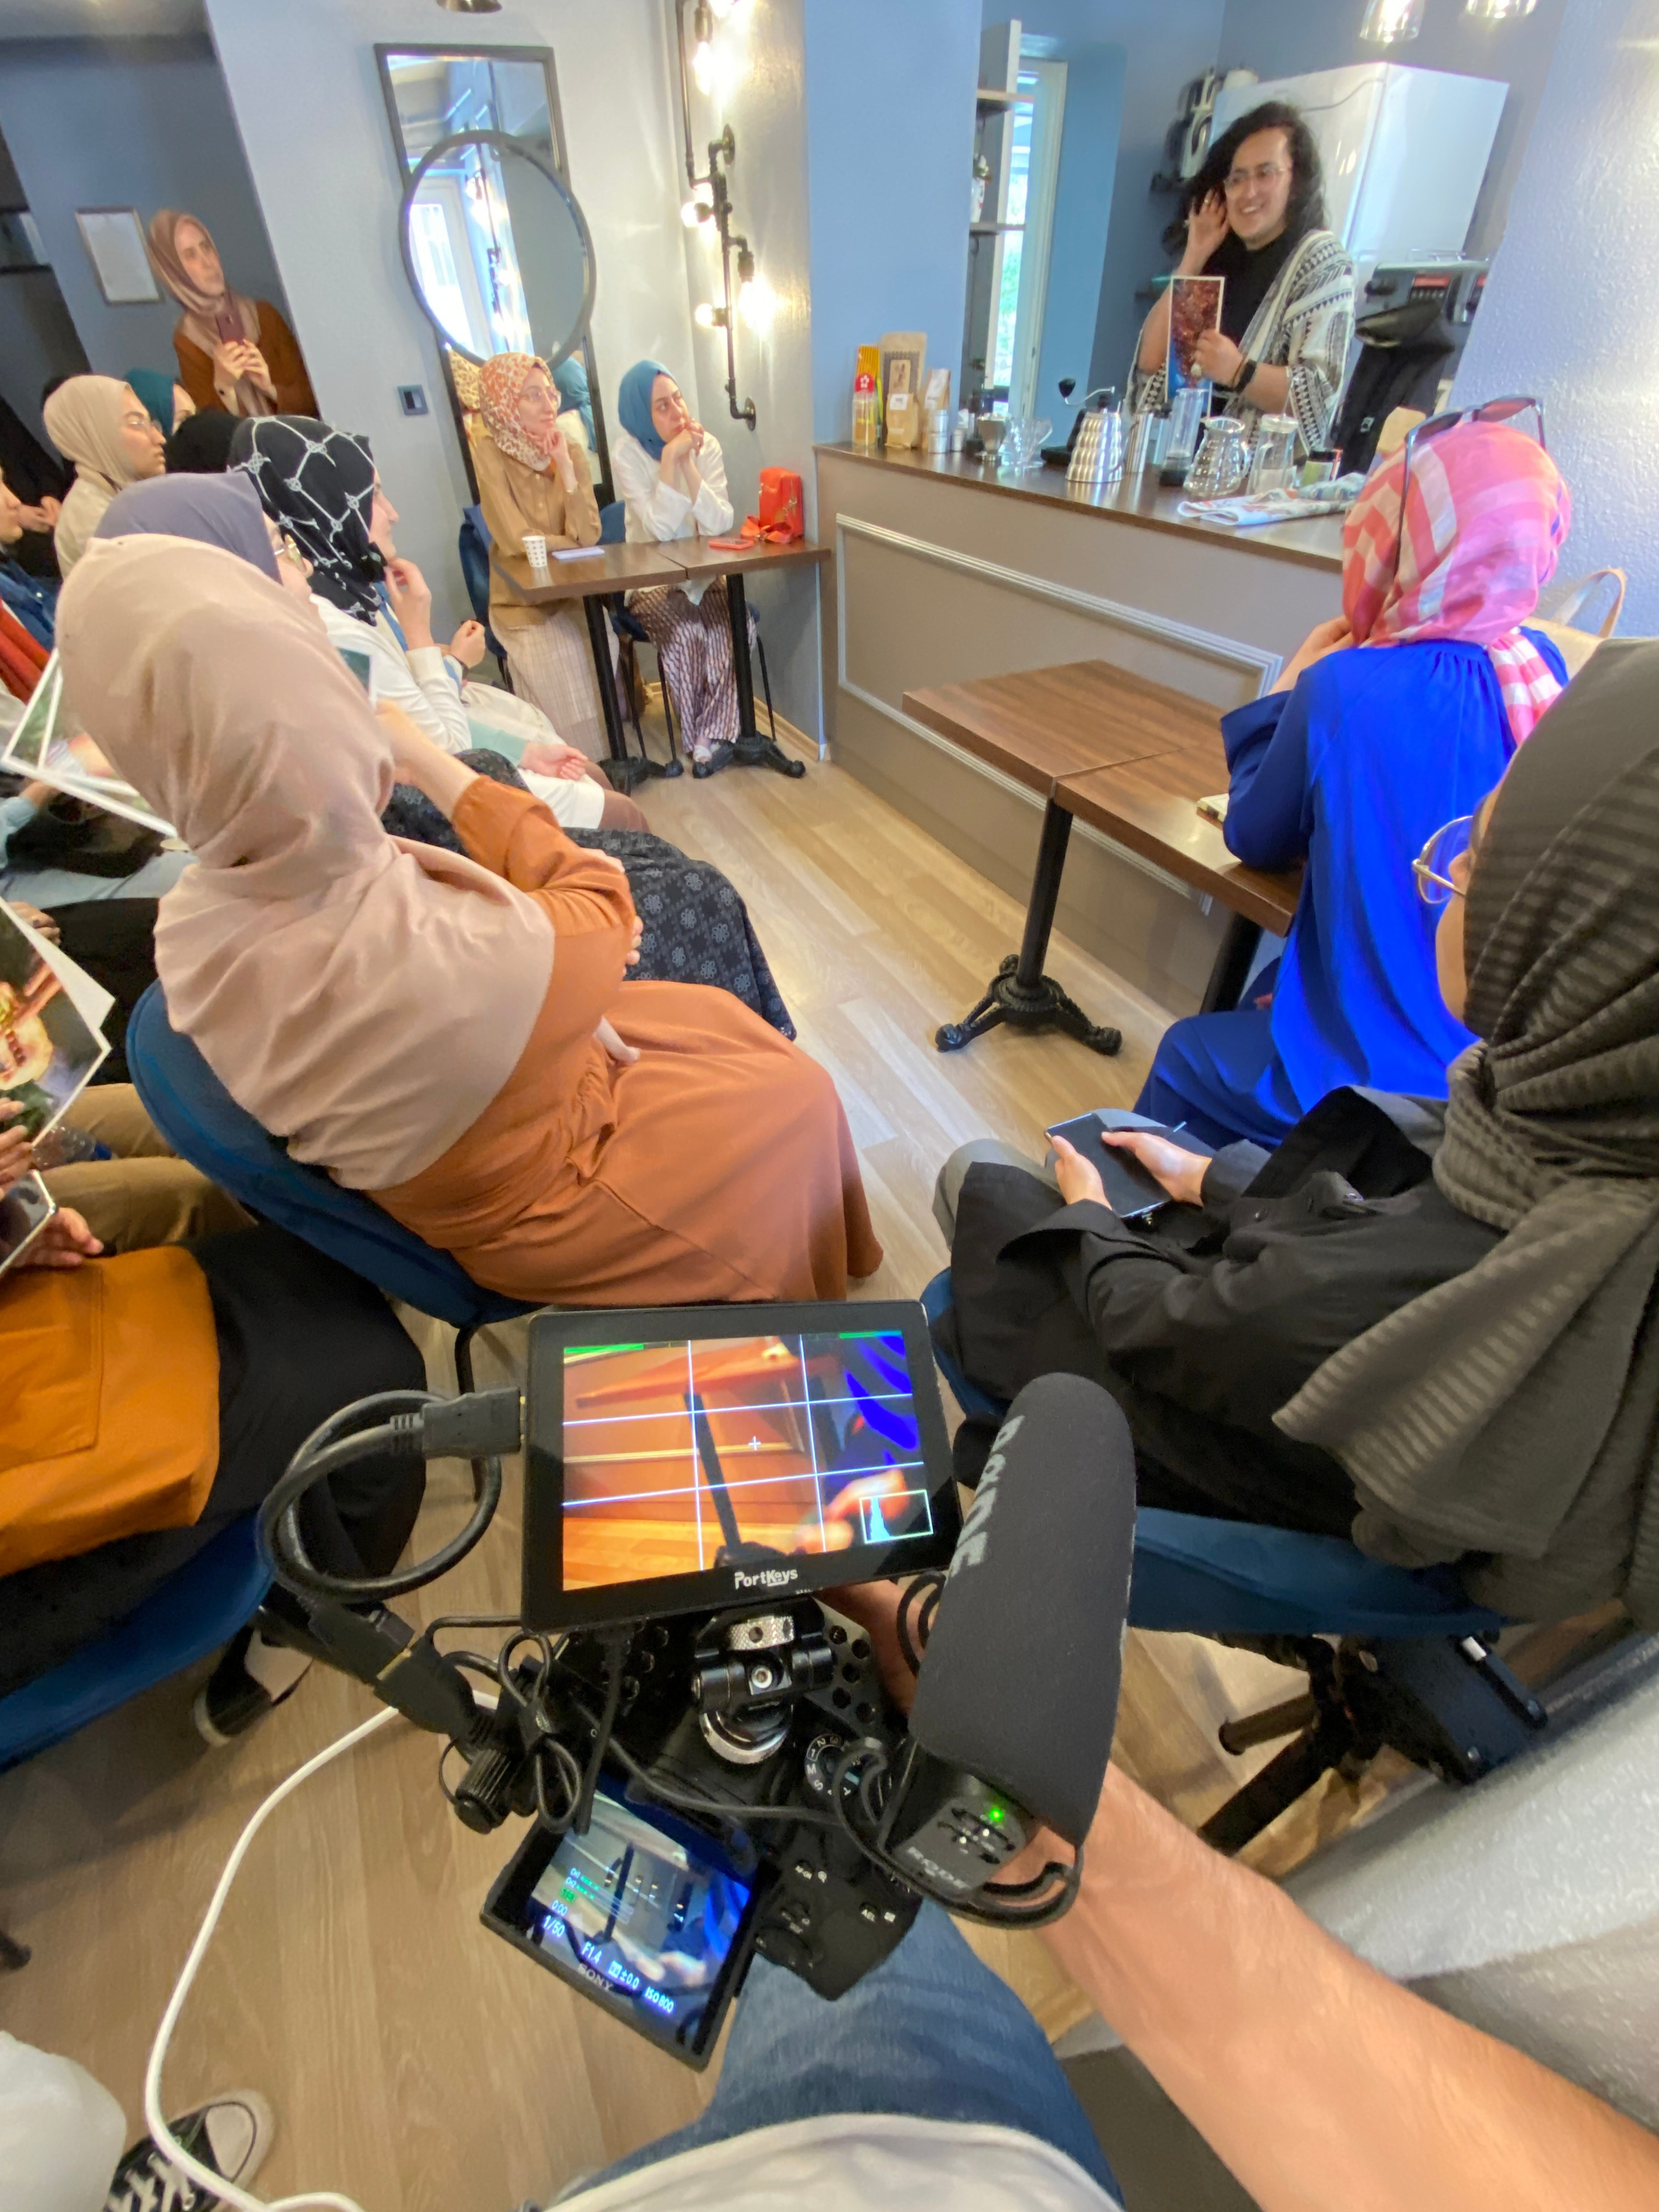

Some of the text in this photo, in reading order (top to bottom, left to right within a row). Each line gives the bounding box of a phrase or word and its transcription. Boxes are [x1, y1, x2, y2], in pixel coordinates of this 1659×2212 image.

[734, 1569, 798, 1590] PortKeys
[807, 1764, 817, 1775] M
[814, 1780, 824, 1791] S
[544, 1915, 566, 1938] 1/50
[582, 1941, 603, 1964] F1.4
[645, 1986, 660, 2003] ISO
[658, 1994, 675, 2014] 800
[578, 1963, 613, 1992] SONY
